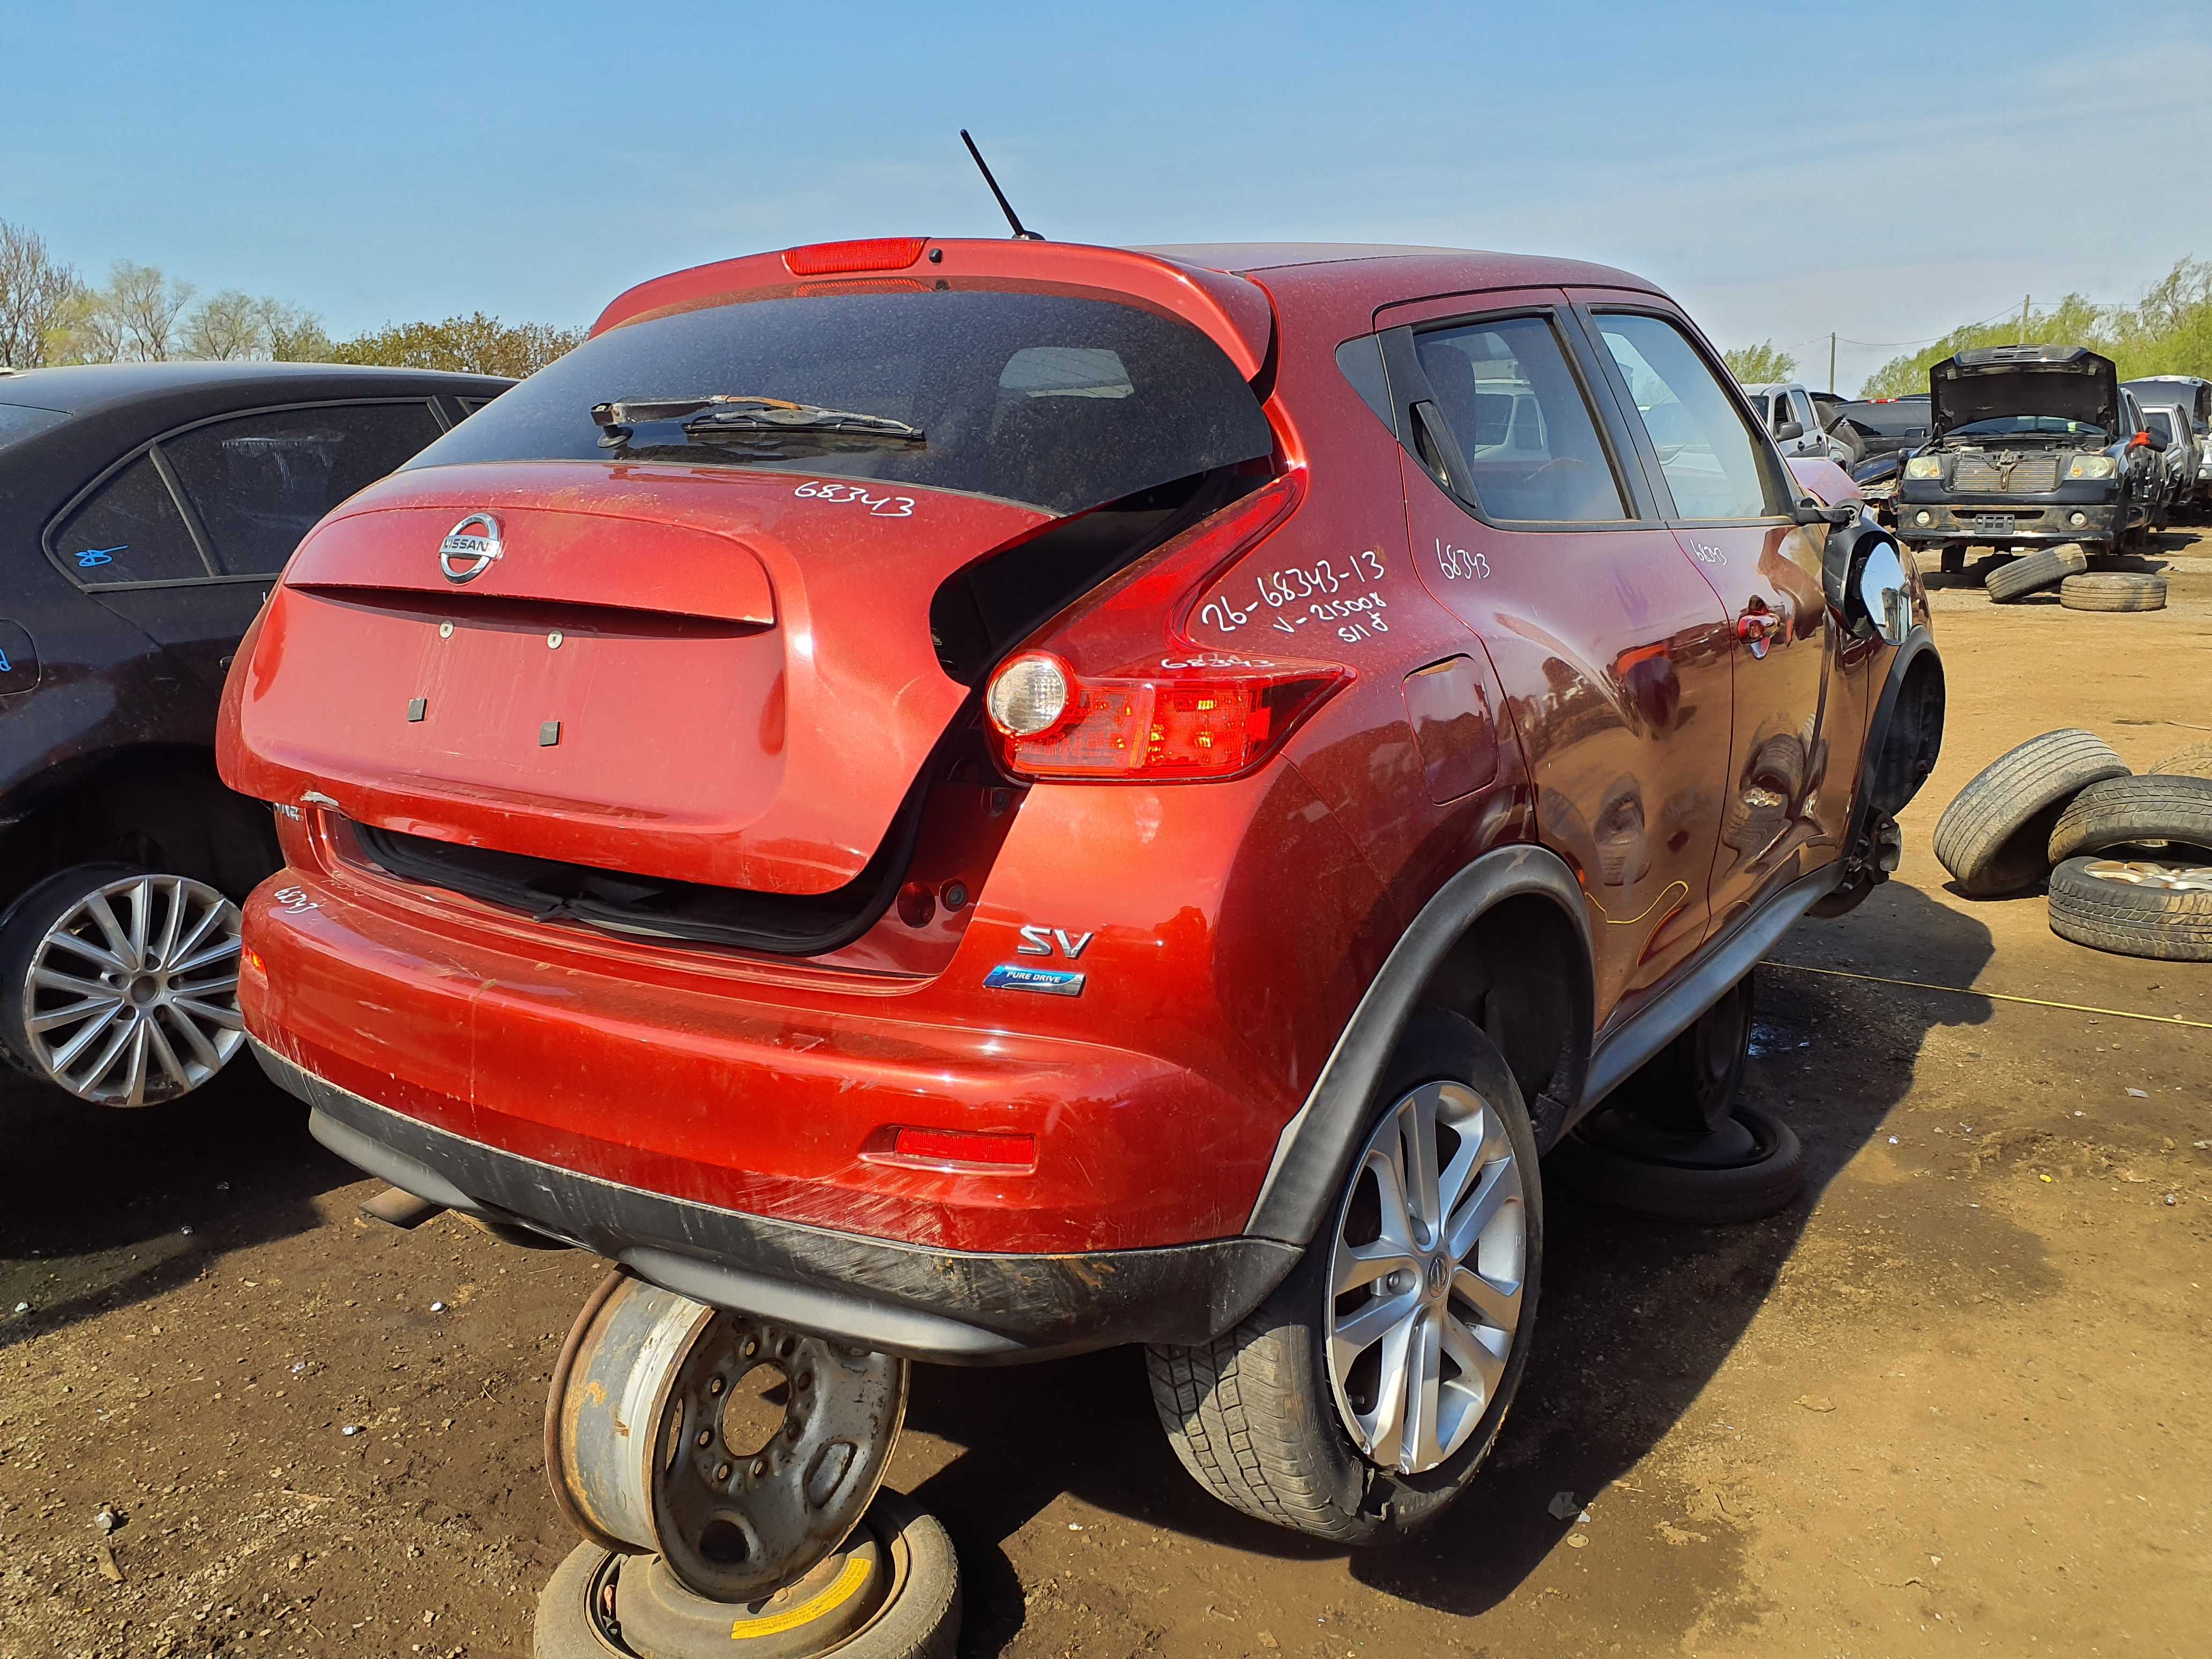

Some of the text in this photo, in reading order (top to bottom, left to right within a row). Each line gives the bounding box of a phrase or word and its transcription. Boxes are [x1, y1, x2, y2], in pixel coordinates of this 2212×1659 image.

[794, 481, 915, 517] 68343
[443, 538, 490, 552] NISSAN
[1436, 537, 1491, 580] 68343
[1690, 538, 1727, 566] 68343
[1201, 550, 1385, 632] 26-68343-13
[1161, 653, 1276, 669] 68343
[1017, 925, 1095, 960] SV
[1006, 971, 1062, 983] PURE DRIVE
